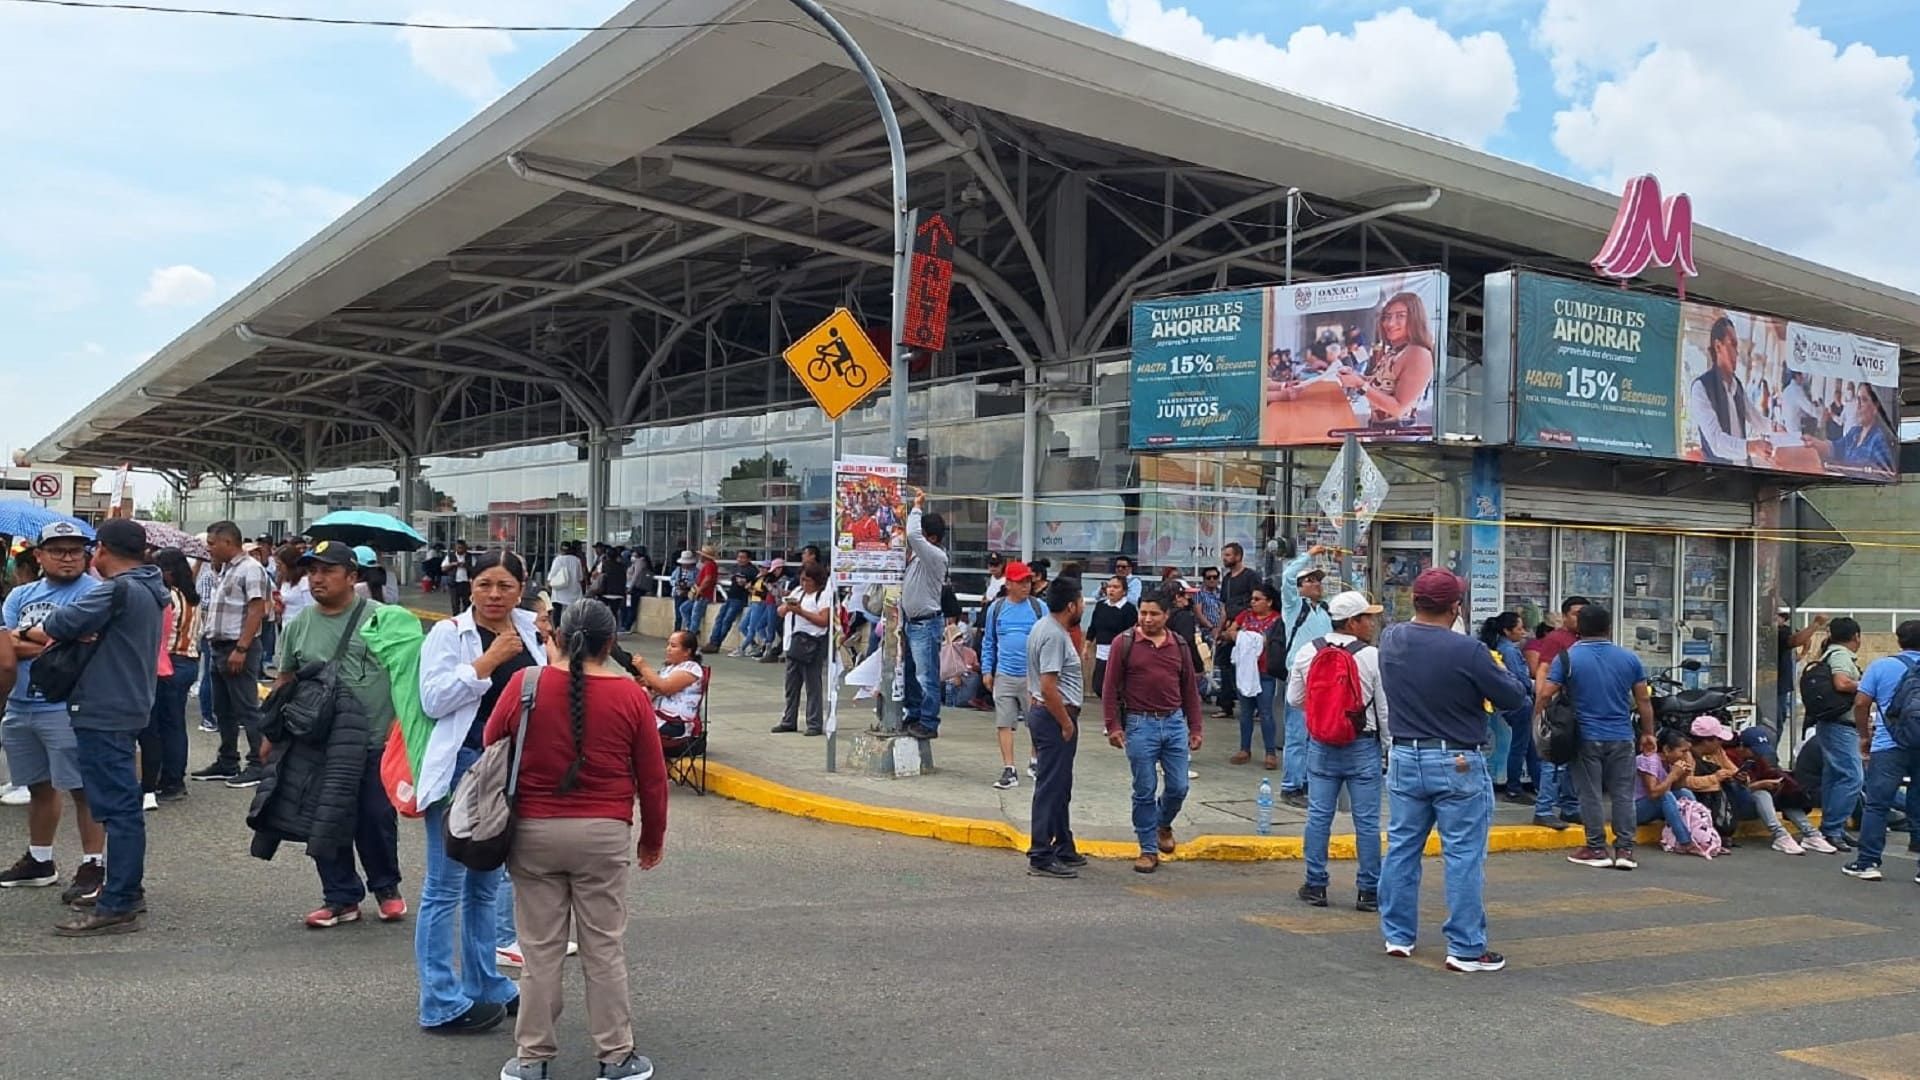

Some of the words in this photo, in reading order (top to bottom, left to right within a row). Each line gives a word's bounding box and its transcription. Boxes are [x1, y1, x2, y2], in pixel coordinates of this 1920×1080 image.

[1318, 286, 1358, 297] OAXACA
[1151, 304, 1221, 321] CUMPLIR
[1224, 301, 1243, 314] ES
[1554, 298, 1623, 325] CUMPLIR
[1626, 310, 1646, 329] ES
[1151, 315, 1241, 338] AHORRAR
[1553, 317, 1642, 353] AHORRAR
[1136, 362, 1167, 374] HASTA
[1170, 354, 1213, 375] 15%
[1852, 353, 1885, 371] JUNTOS
[1525, 369, 1563, 390] HASTA
[1566, 366, 1618, 402] 15%
[1157, 402, 1219, 418] JUNTOS
